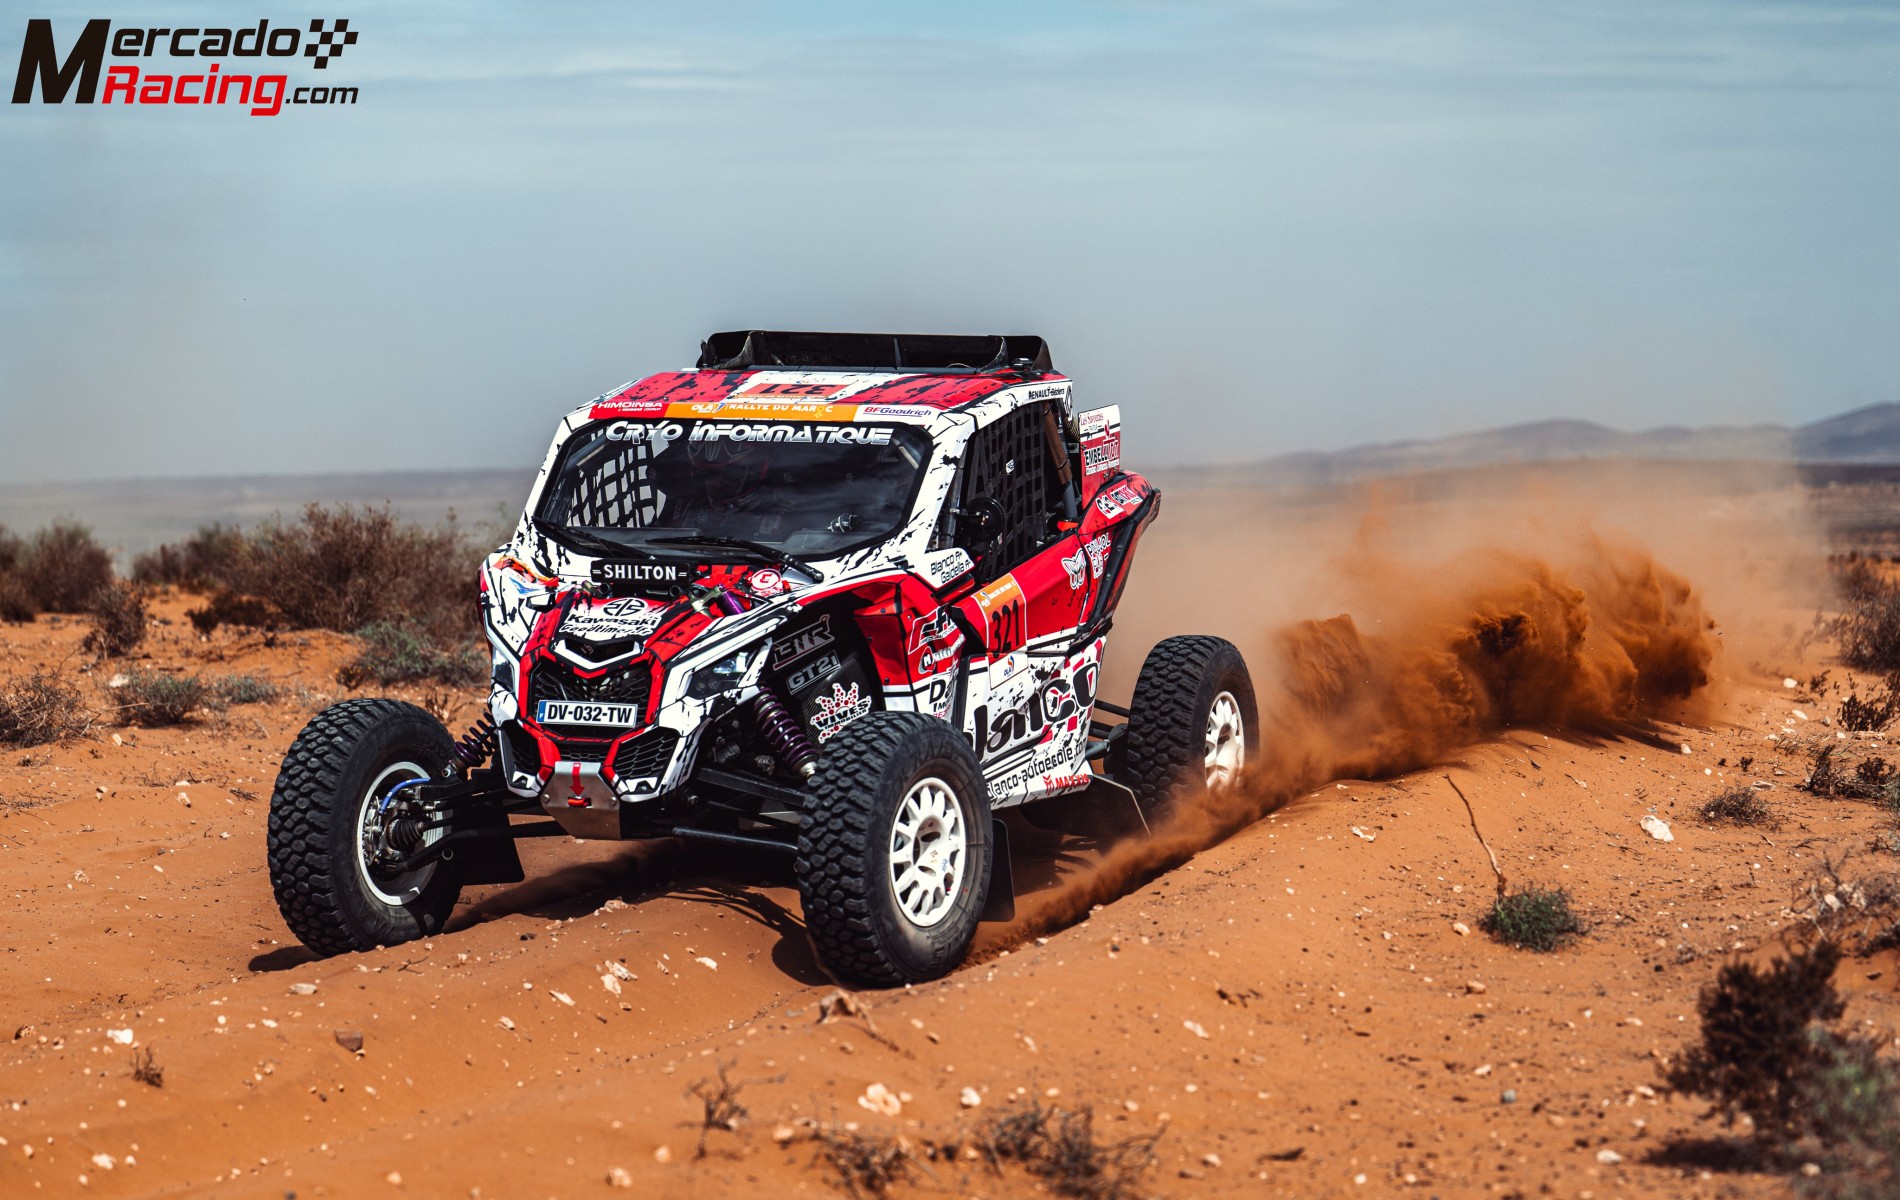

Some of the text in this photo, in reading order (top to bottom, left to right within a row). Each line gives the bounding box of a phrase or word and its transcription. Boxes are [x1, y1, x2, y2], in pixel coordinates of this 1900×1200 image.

[792, 405, 834, 413] MAROC
[863, 406, 932, 416] BFGoodrich
[603, 564, 677, 580] SHILTON
[930, 550, 963, 576] Blanco A+
[566, 613, 659, 627] Kawasaki
[991, 599, 1020, 659] 321
[787, 652, 839, 690] GT2i
[547, 704, 633, 724] DV-032-TW
[815, 701, 869, 728] VIVES
[1054, 773, 1091, 789] MAXXIS
